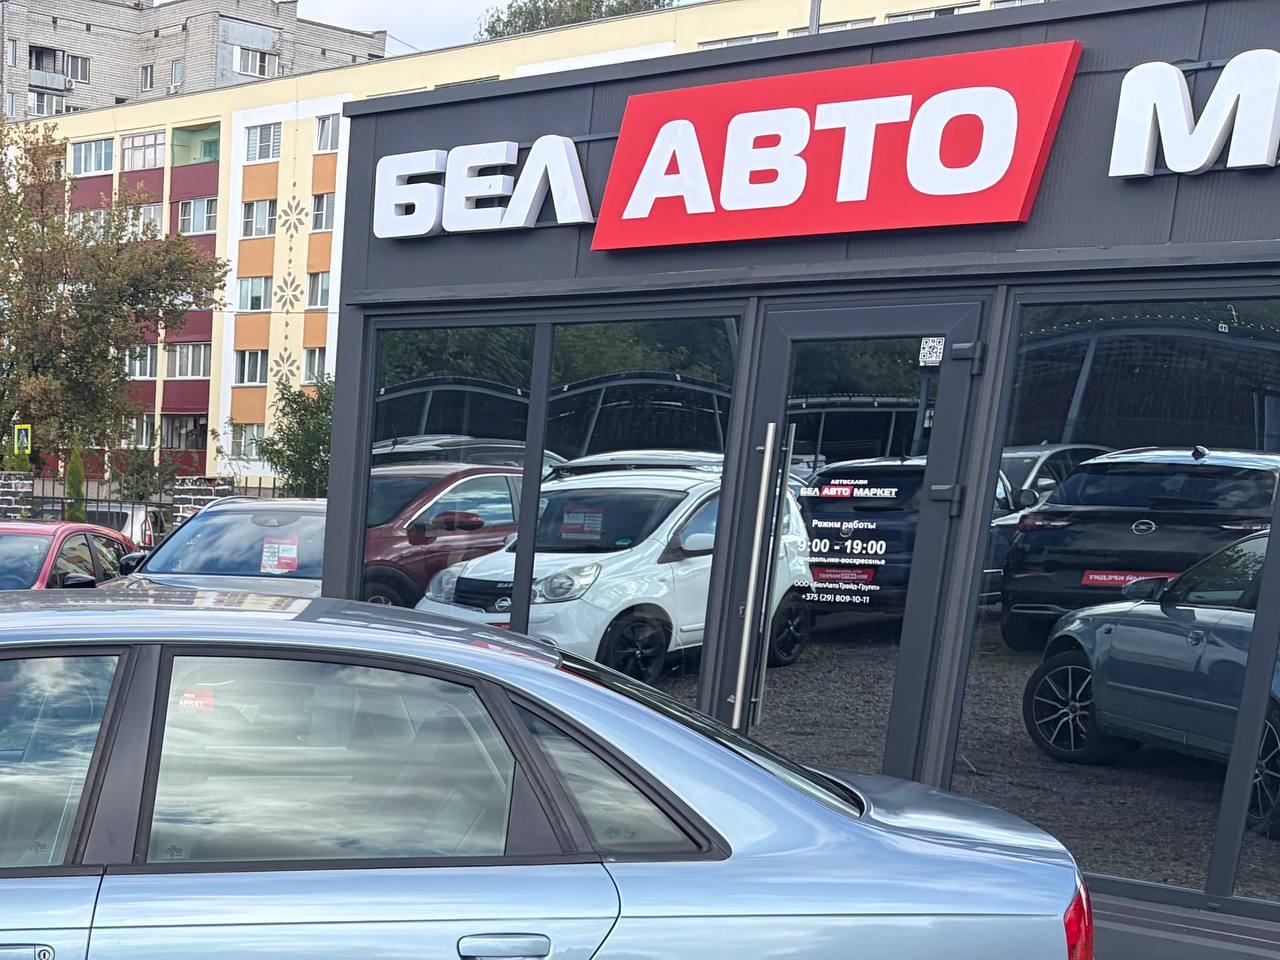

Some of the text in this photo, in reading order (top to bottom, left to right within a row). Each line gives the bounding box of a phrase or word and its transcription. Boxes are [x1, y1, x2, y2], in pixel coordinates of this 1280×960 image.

[373, 134, 594, 239] БЕЛ
[622, 86, 1018, 219] АВТО
[800, 487, 898, 497] БЕЛ АВТО МАРКЕТ
[812, 519, 876, 529] Режим работы
[799, 538, 830, 553] 9:00
[844, 539, 886, 554] 19:00
[820, 593, 834, 602] (29)
[835, 595, 869, 603] 809-10-11
